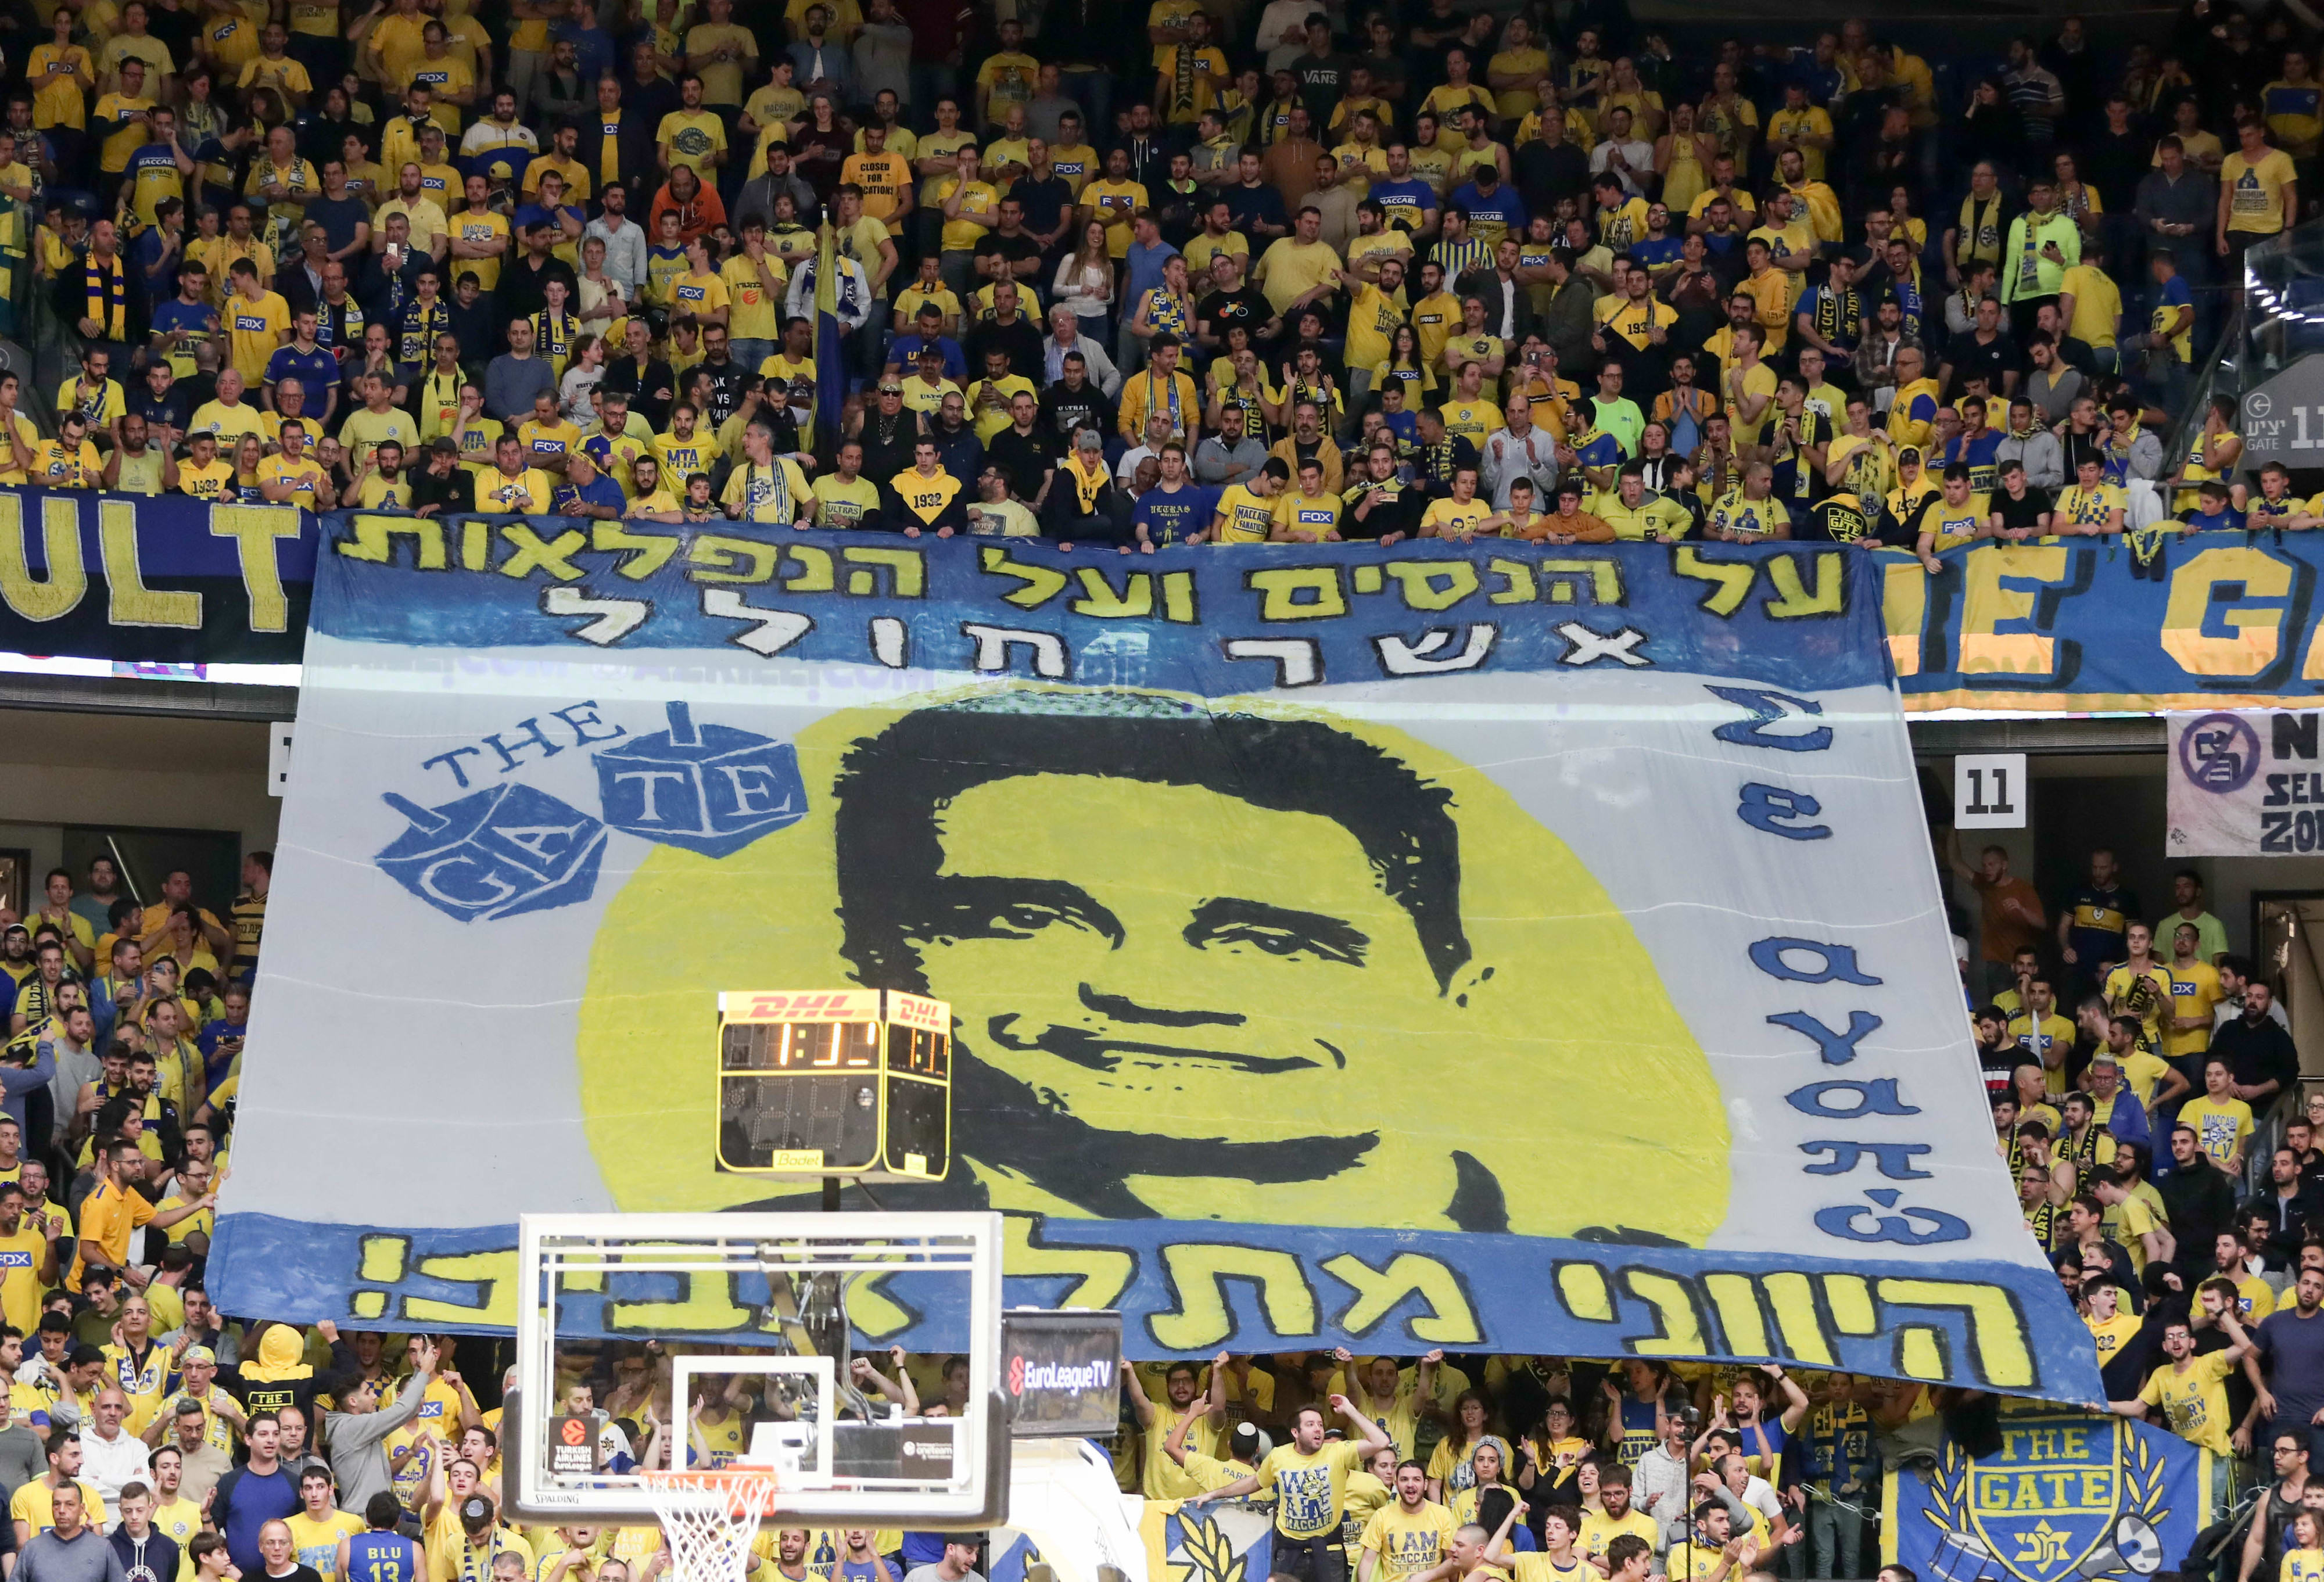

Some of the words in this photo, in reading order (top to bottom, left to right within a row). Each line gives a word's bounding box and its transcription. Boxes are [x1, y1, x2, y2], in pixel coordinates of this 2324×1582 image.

[418, 74, 446, 82] FOX
[1303, 70, 1337, 84] VANS
[860, 163, 890, 171] CLOSED
[1056, 164, 1083, 173] FOX
[422, 180, 443, 188] OX
[867, 174, 883, 183] FOR
[861, 186, 894, 195] CATIONS
[1102, 198, 1131, 206] FX
[677, 287, 702, 298] FOX
[236, 316, 264, 329] FOX
[1627, 324, 1648, 335] 193
[716, 394, 730, 405] VS
[2246, 419, 2285, 436] יציע
[534, 441, 564, 453] FOX
[2247, 438, 2279, 451] GATE
[667, 449, 700, 466] MTA
[193, 480, 219, 494] 1932
[913, 493, 942, 509] 1932
[828, 504, 859, 515] ULTRAS
[1238, 508, 1270, 522] MACCABI
[1301, 511, 1331, 522] FOX
[1837, 507, 1857, 521] THE
[1830, 516, 1860, 536] GATE
[337, 513, 928, 599] הנפלאות
[976, 543, 1202, 625] ועל
[1670, 543, 1851, 620] על
[1242, 556, 1627, 623] הנסים
[538, 585, 1072, 681] חולל
[1222, 620, 1655, 689] אשר
[421, 699, 627, 789] THE
[1965, 768, 2014, 815] 11
[2173, 984, 2195, 993] OX
[748, 996, 855, 1018] DHL
[899, 998, 941, 1027] DHL
[2203, 1115, 2237, 1128] MACCABI
[1000, 1211, 1486, 1353] מתל
[1551, 1257, 2040, 1390] היווני
[1024, 1359, 1111, 1396] EuroLeagueTV
[258, 1394, 284, 1404] THE
[555, 1445, 592, 1454] TURKISH
[2000, 1427, 2090, 1461] THE
[555, 1454, 592, 1462] AIRLINES
[554, 1462, 592, 1472] EuroLeague
[1979, 1470, 2113, 1510] GATE
[535, 1494, 580, 1505] SPALDING
[1285, 1512, 1333, 1532] MACCABI
[1402, 1530, 1439, 1553] AM
[368, 1546, 402, 1559] BLU
[1391, 1551, 1436, 1565] MACCABI
[369, 1561, 401, 1582] 13
